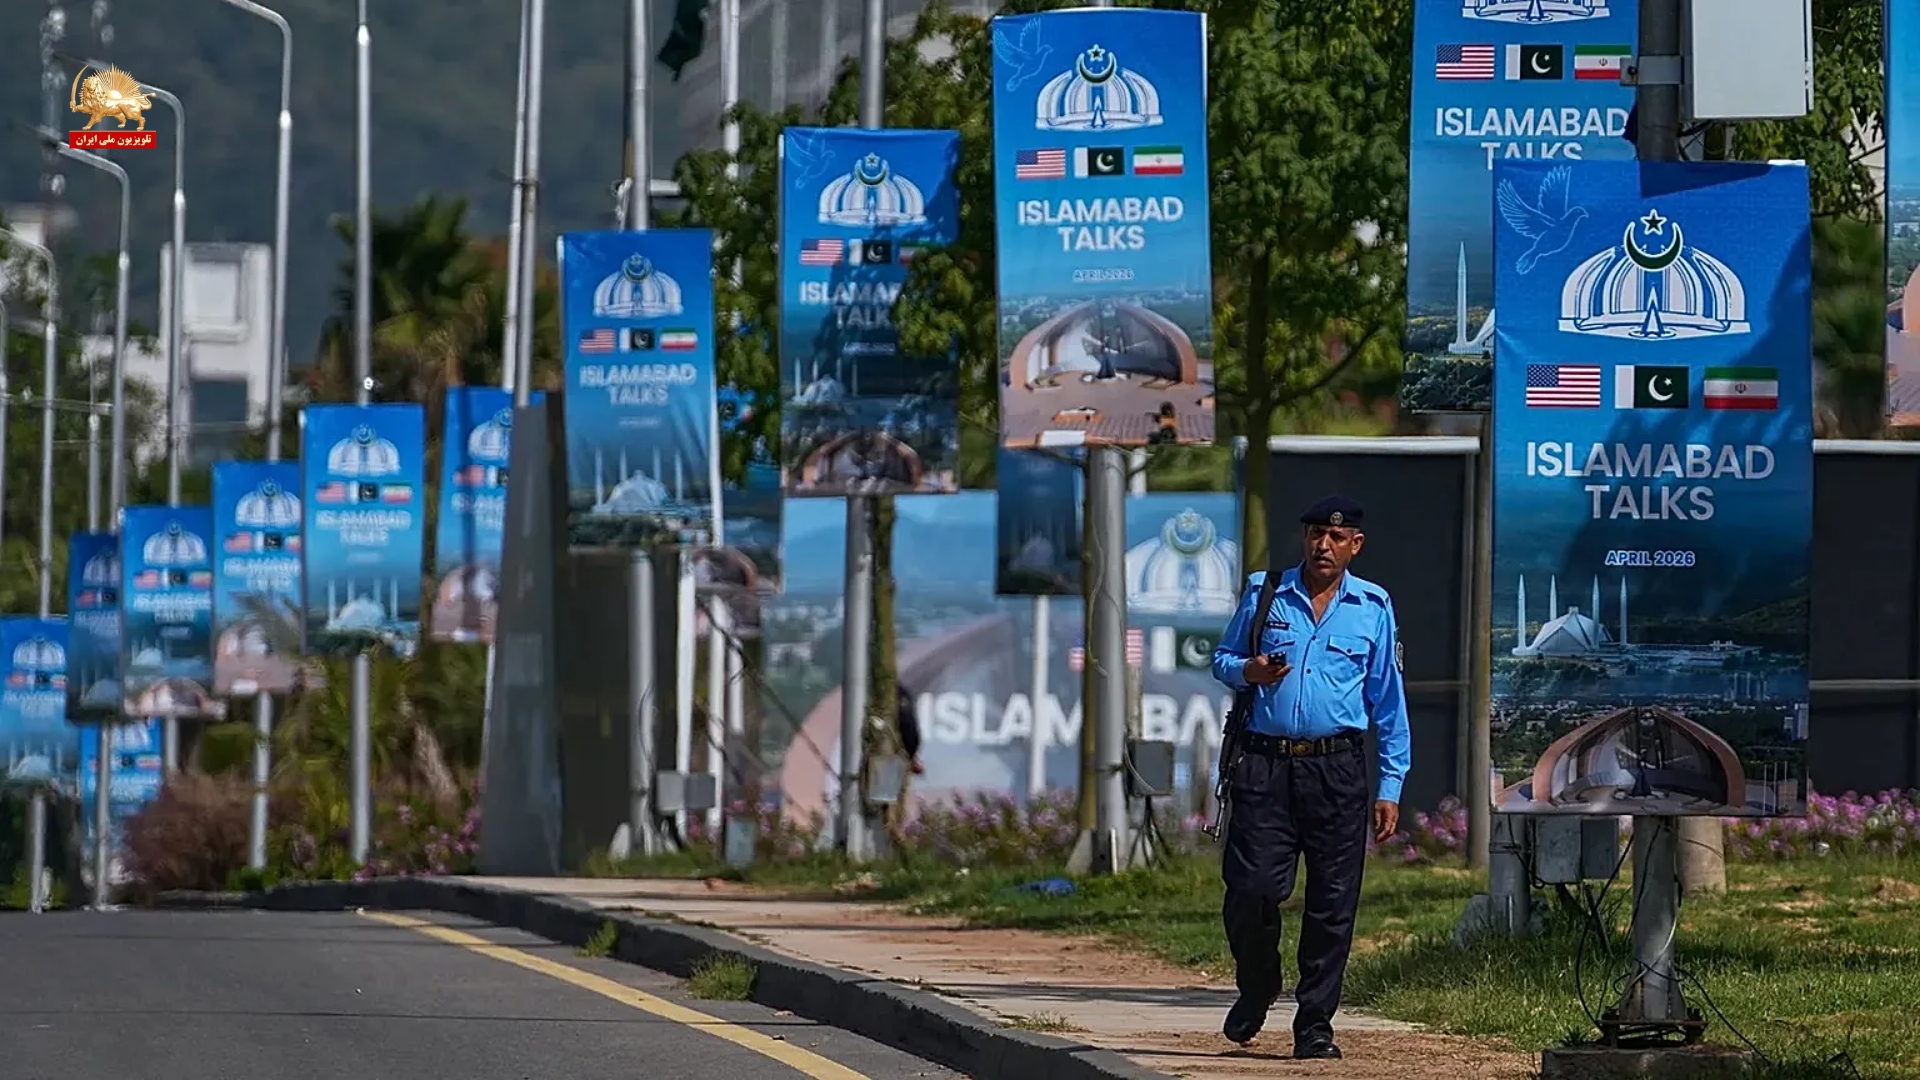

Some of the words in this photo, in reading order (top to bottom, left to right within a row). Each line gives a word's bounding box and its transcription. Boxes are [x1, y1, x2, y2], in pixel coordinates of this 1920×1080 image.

[1435, 107, 1628, 136] ISLAMABAD
[1017, 197, 1184, 225] ISLAMABAD
[1058, 225, 1146, 250] TALKS
[834, 304, 891, 330] TALK
[579, 363, 697, 388] ISLAMABAD
[1527, 442, 1774, 479] ISLAMABAD
[1585, 485, 1715, 520] TALKS
[1604, 550, 1652, 566] APRIL
[1653, 550, 1696, 567] 2026
